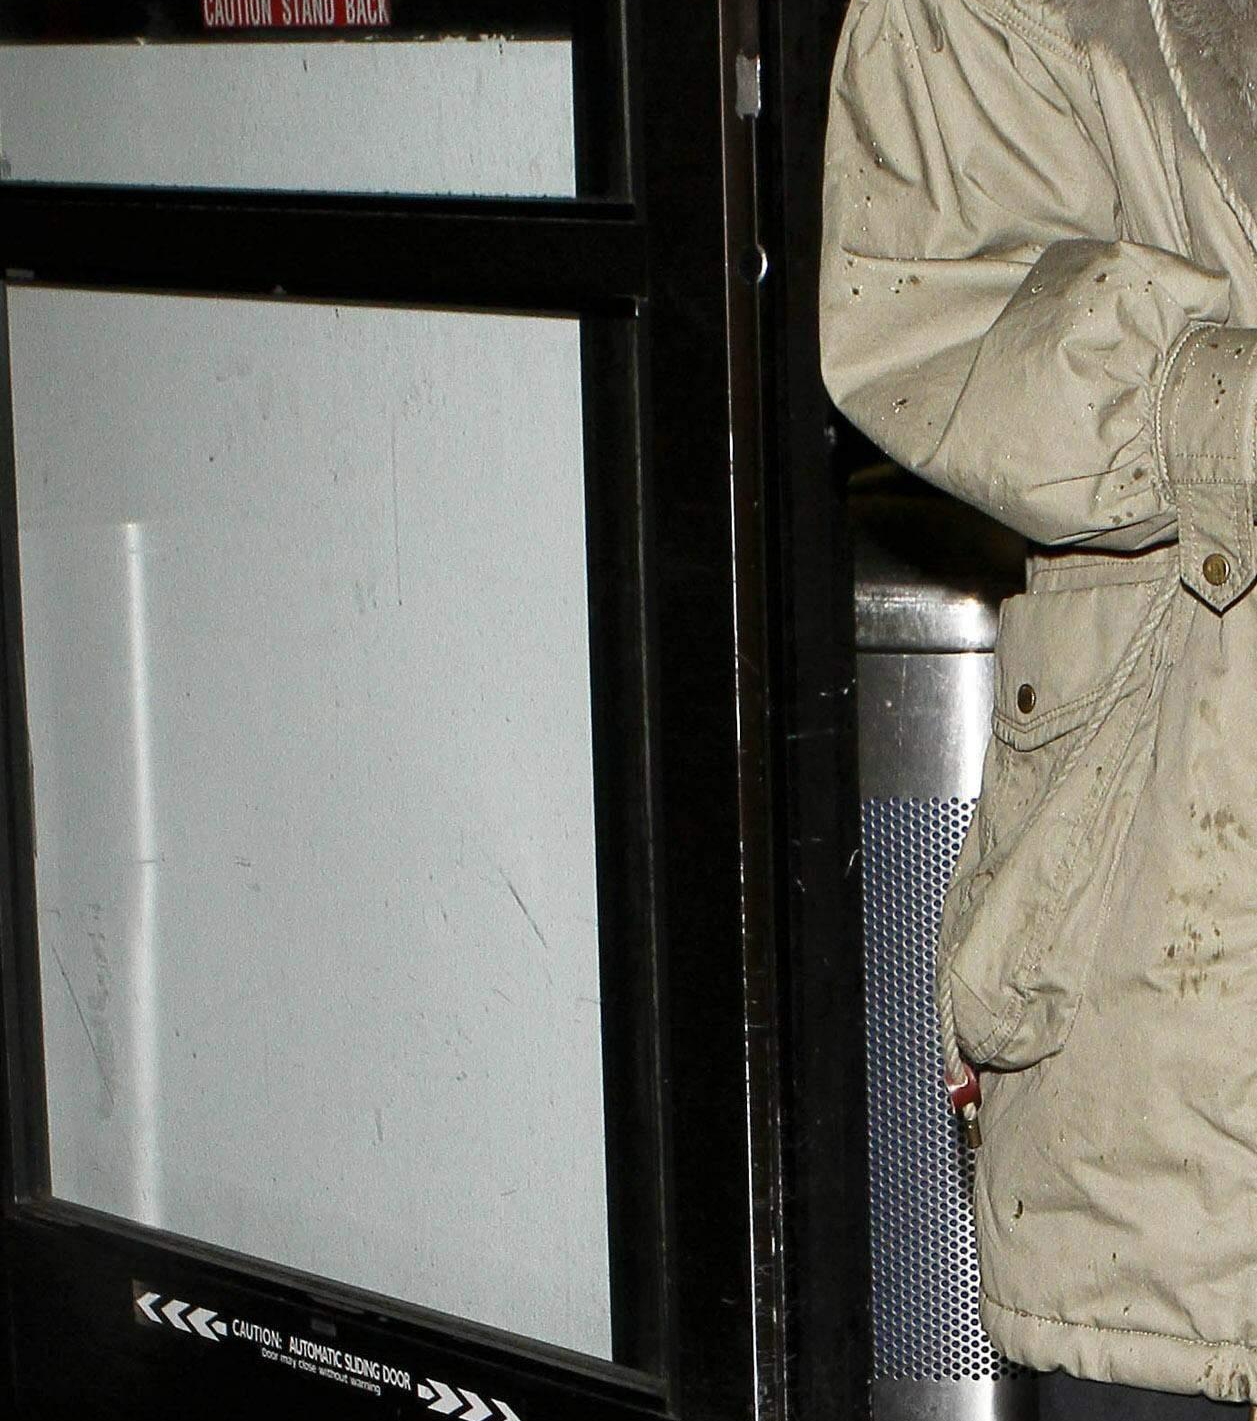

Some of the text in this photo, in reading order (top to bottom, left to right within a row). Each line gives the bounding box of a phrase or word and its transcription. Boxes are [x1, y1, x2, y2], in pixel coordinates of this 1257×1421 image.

[232, 1318, 412, 1391] CAUTION: AUTOMATIC SLIDING DOOR
[261, 1347, 279, 1361] Door
[349, 1376, 381, 1397] warning
